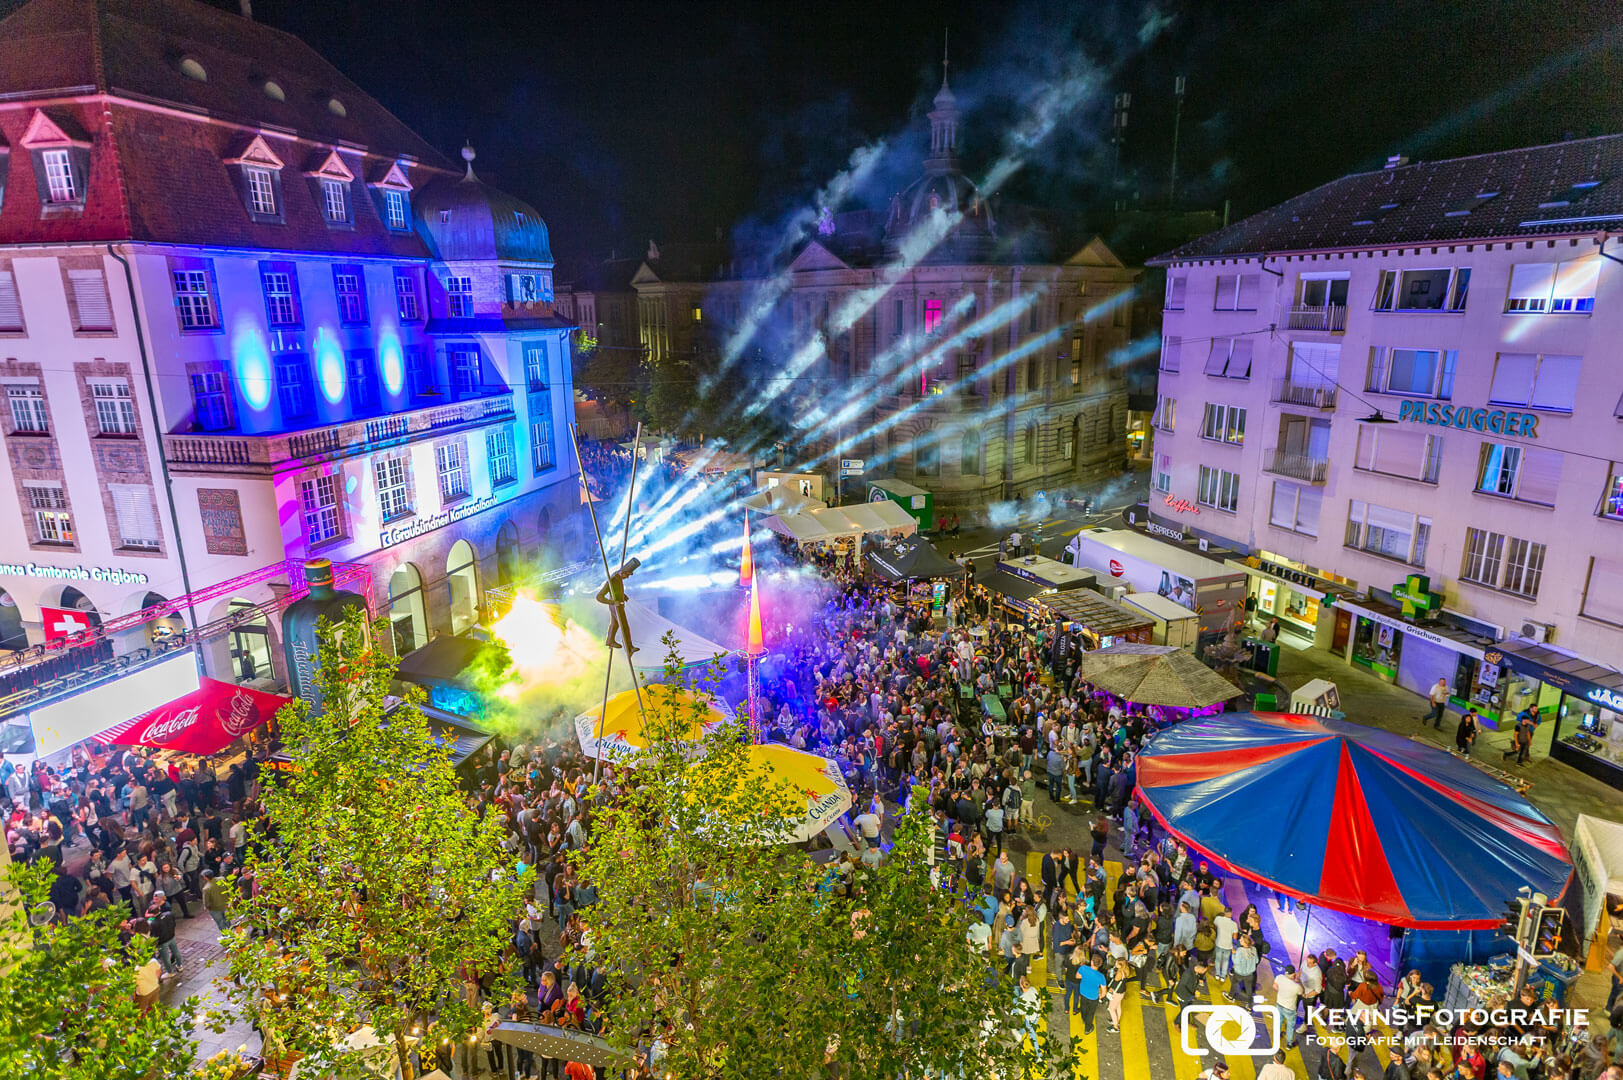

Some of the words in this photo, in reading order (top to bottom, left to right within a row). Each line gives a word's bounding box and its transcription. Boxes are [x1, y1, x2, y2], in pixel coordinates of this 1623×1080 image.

[1399, 400, 1539, 438] PASSUGGER
[1164, 494, 1200, 514] Coiffure
[392, 514, 448, 543] Graubündner
[449, 495, 498, 522] Kantonalbank
[1146, 520, 1183, 541] NESPRESSO
[26, 563, 90, 580] Cantonale
[91, 567, 148, 585] Grigione
[1406, 625, 1441, 643] Grischuna
[809, 794, 841, 820] CALANDA
